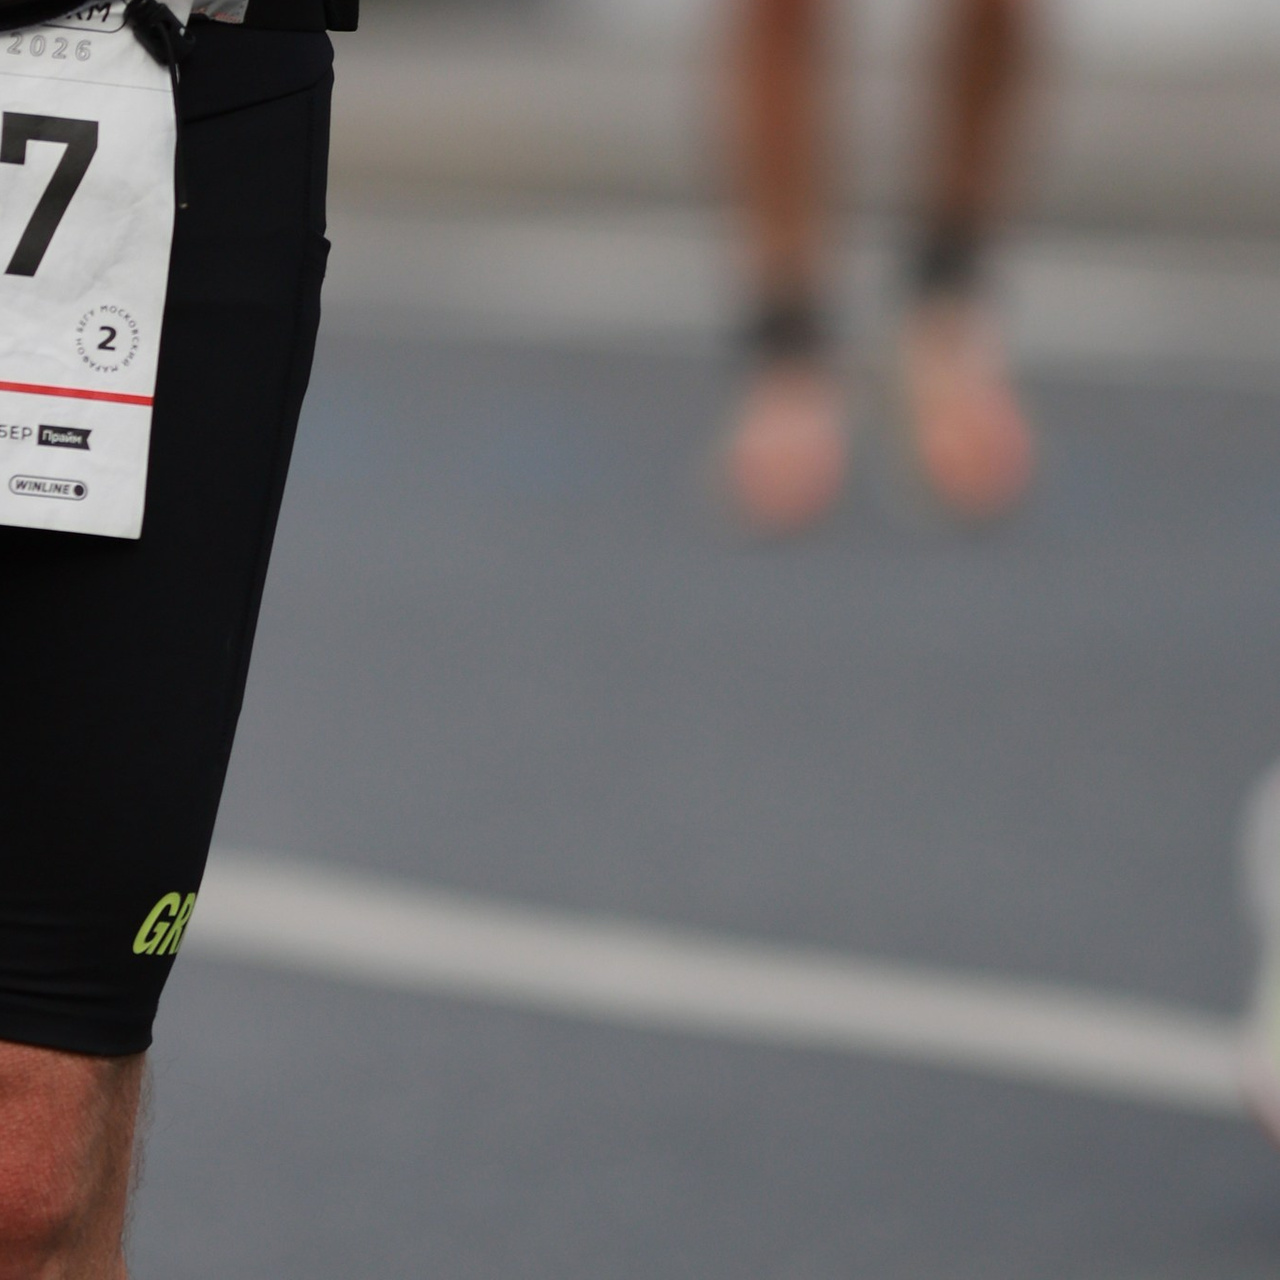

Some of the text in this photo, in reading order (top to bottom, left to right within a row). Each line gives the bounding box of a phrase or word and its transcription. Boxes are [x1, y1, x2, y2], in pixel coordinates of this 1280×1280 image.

[6, 31, 93, 62] 2026
[97, 326, 118, 351] 2
[42, 429, 83, 447] Прайм
[15, 479, 71, 495] WINLINE
